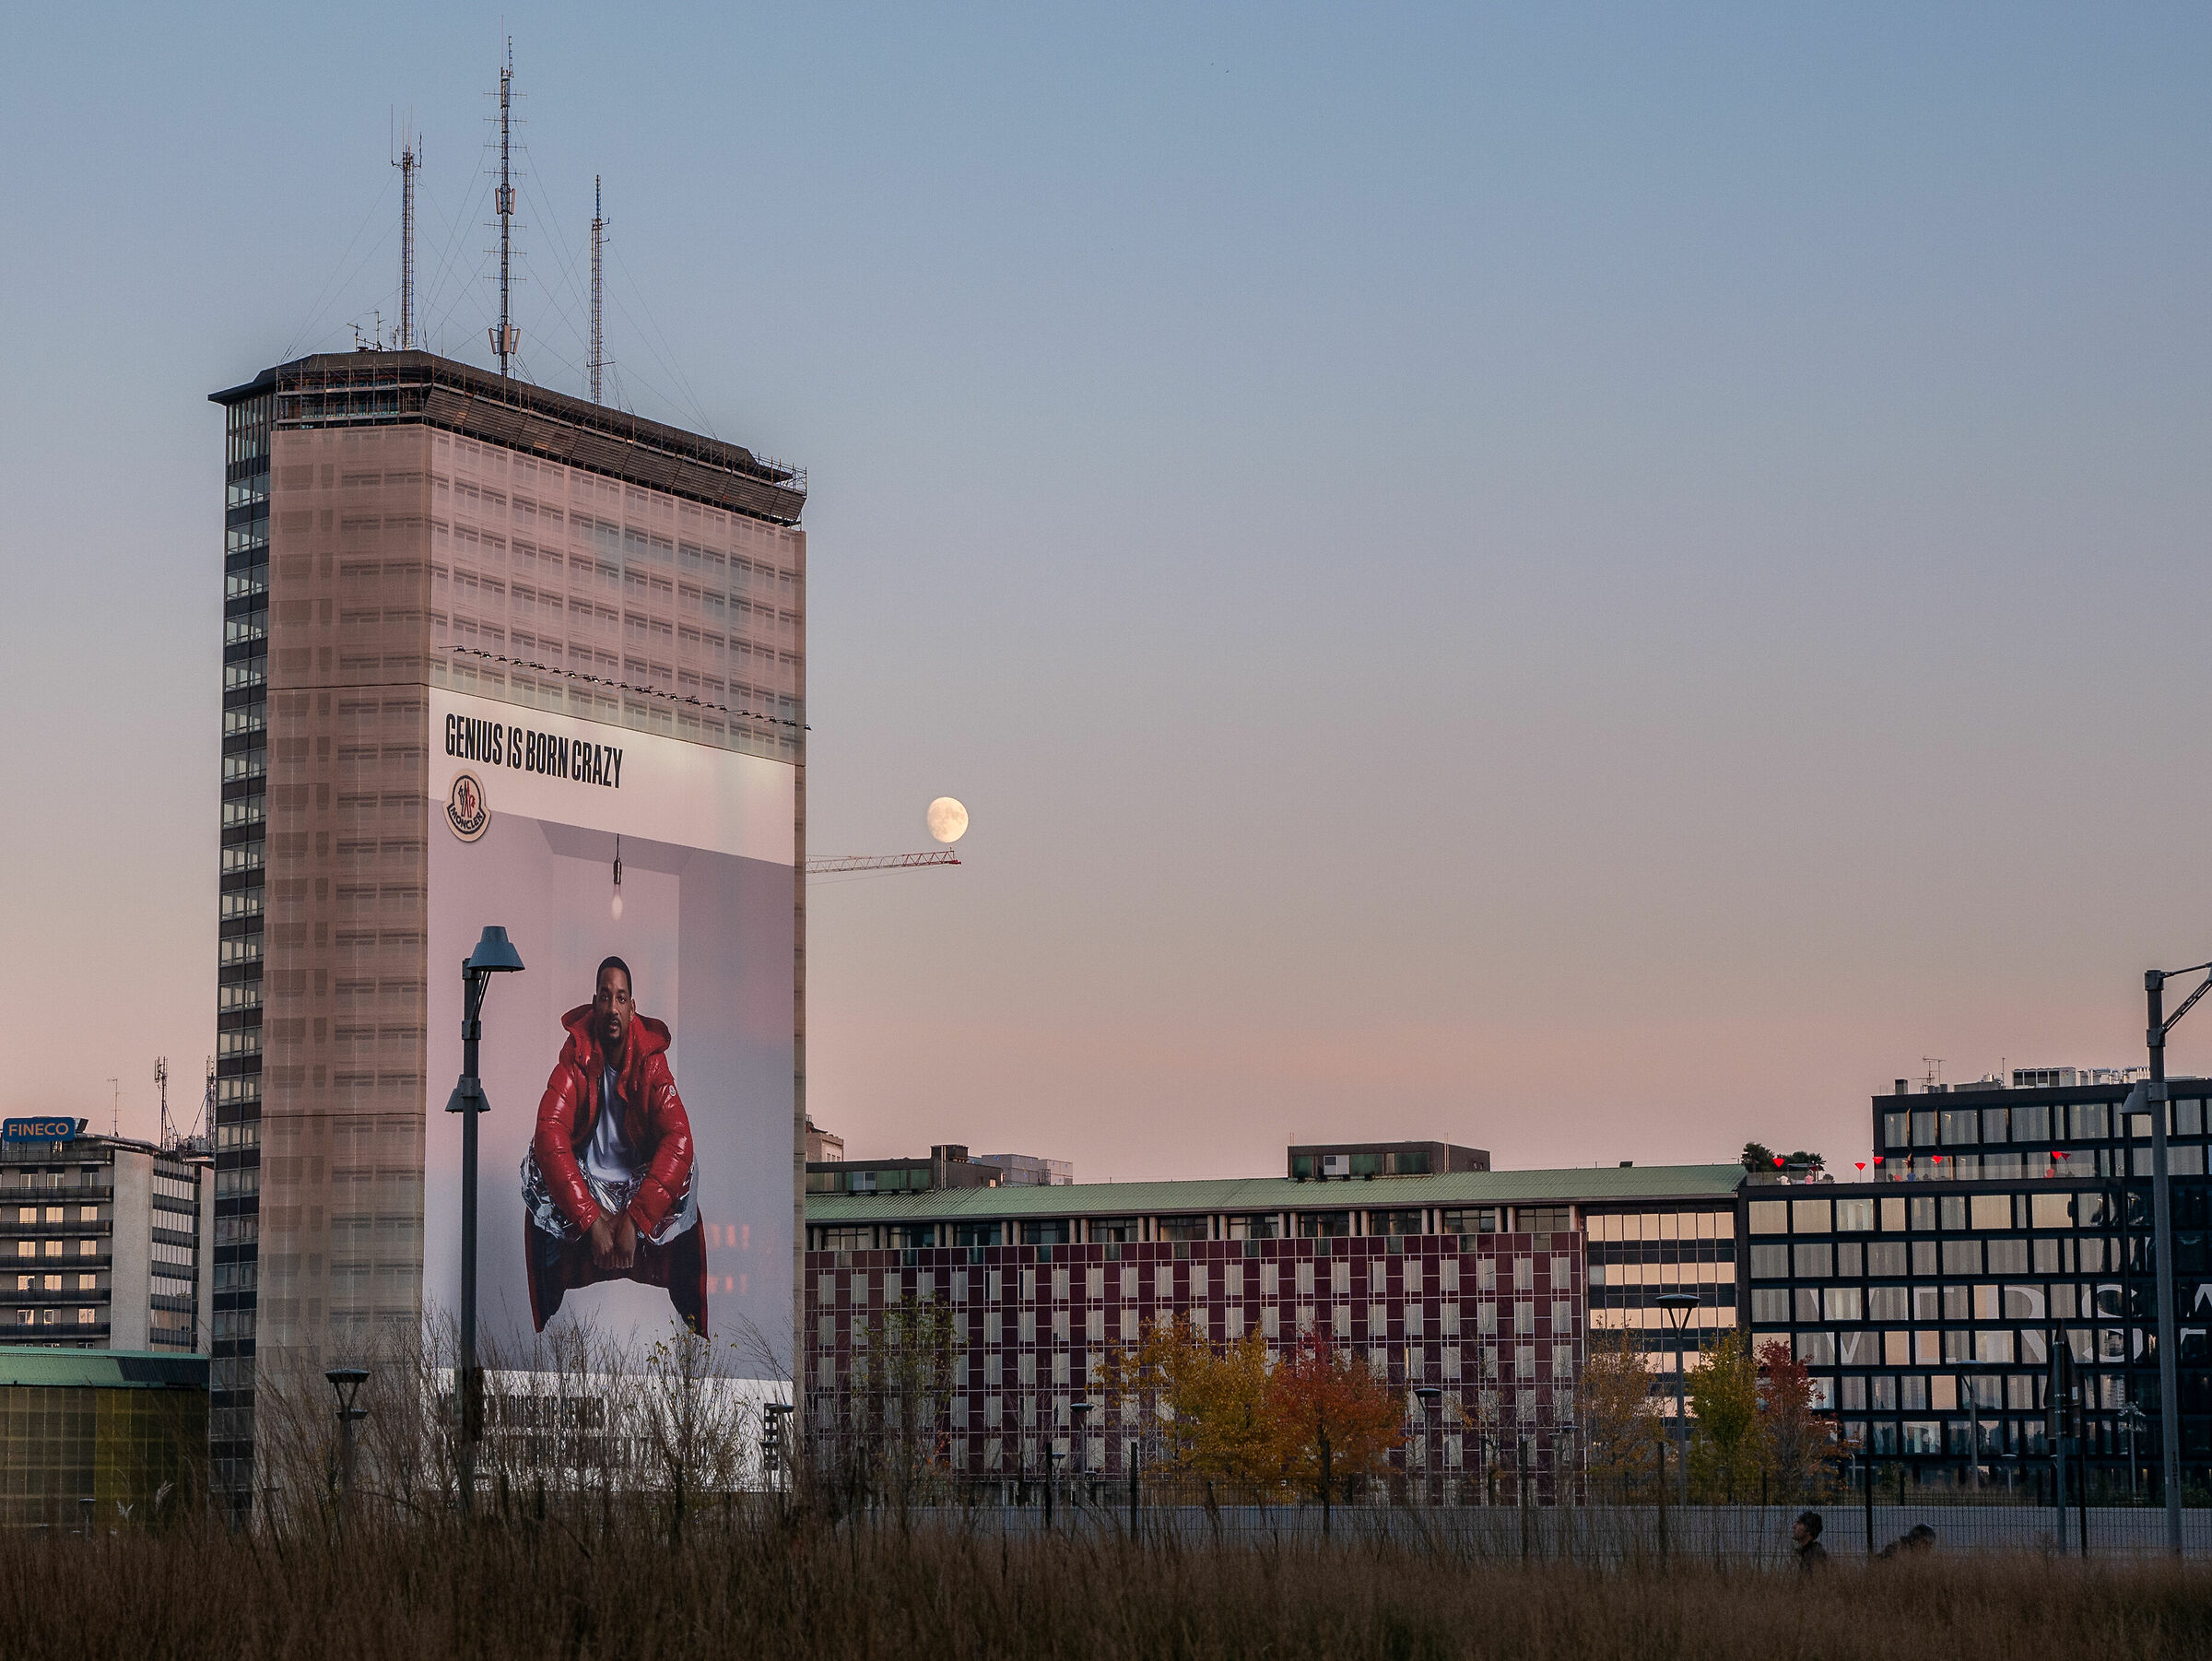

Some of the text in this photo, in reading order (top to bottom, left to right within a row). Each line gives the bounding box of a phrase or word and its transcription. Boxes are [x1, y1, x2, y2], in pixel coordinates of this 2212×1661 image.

[445, 713, 623, 789] GENIUS IS BORN CRAZY
[450, 807, 484, 830] MONCLER
[8, 1122, 69, 1137] FINECO
